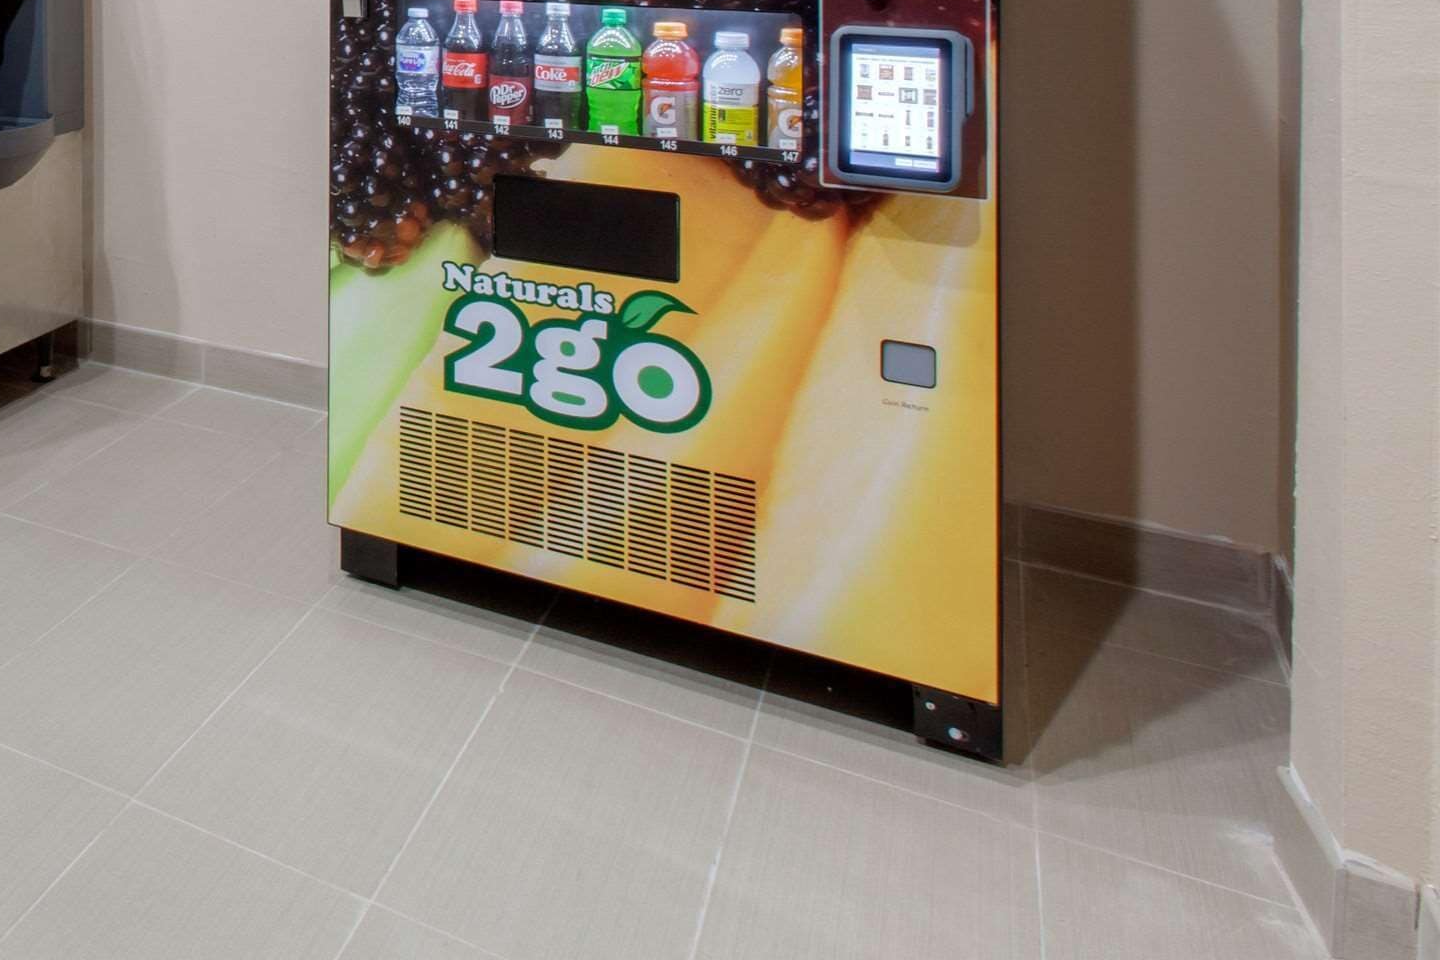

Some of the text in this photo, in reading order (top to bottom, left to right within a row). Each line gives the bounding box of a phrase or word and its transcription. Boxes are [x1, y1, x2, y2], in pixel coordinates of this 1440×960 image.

[535, 65, 568, 81] Coke
[718, 87, 744, 97] zero
[650, 96, 677, 125] G
[444, 120, 458, 129] 141
[494, 125, 509, 135] 142
[548, 130, 563, 139] 143
[602, 135, 619, 145] 144
[660, 141, 678, 151] 145
[720, 146, 738, 156] 146
[782, 152, 799, 161] 147
[443, 262, 615, 314] Naturals
